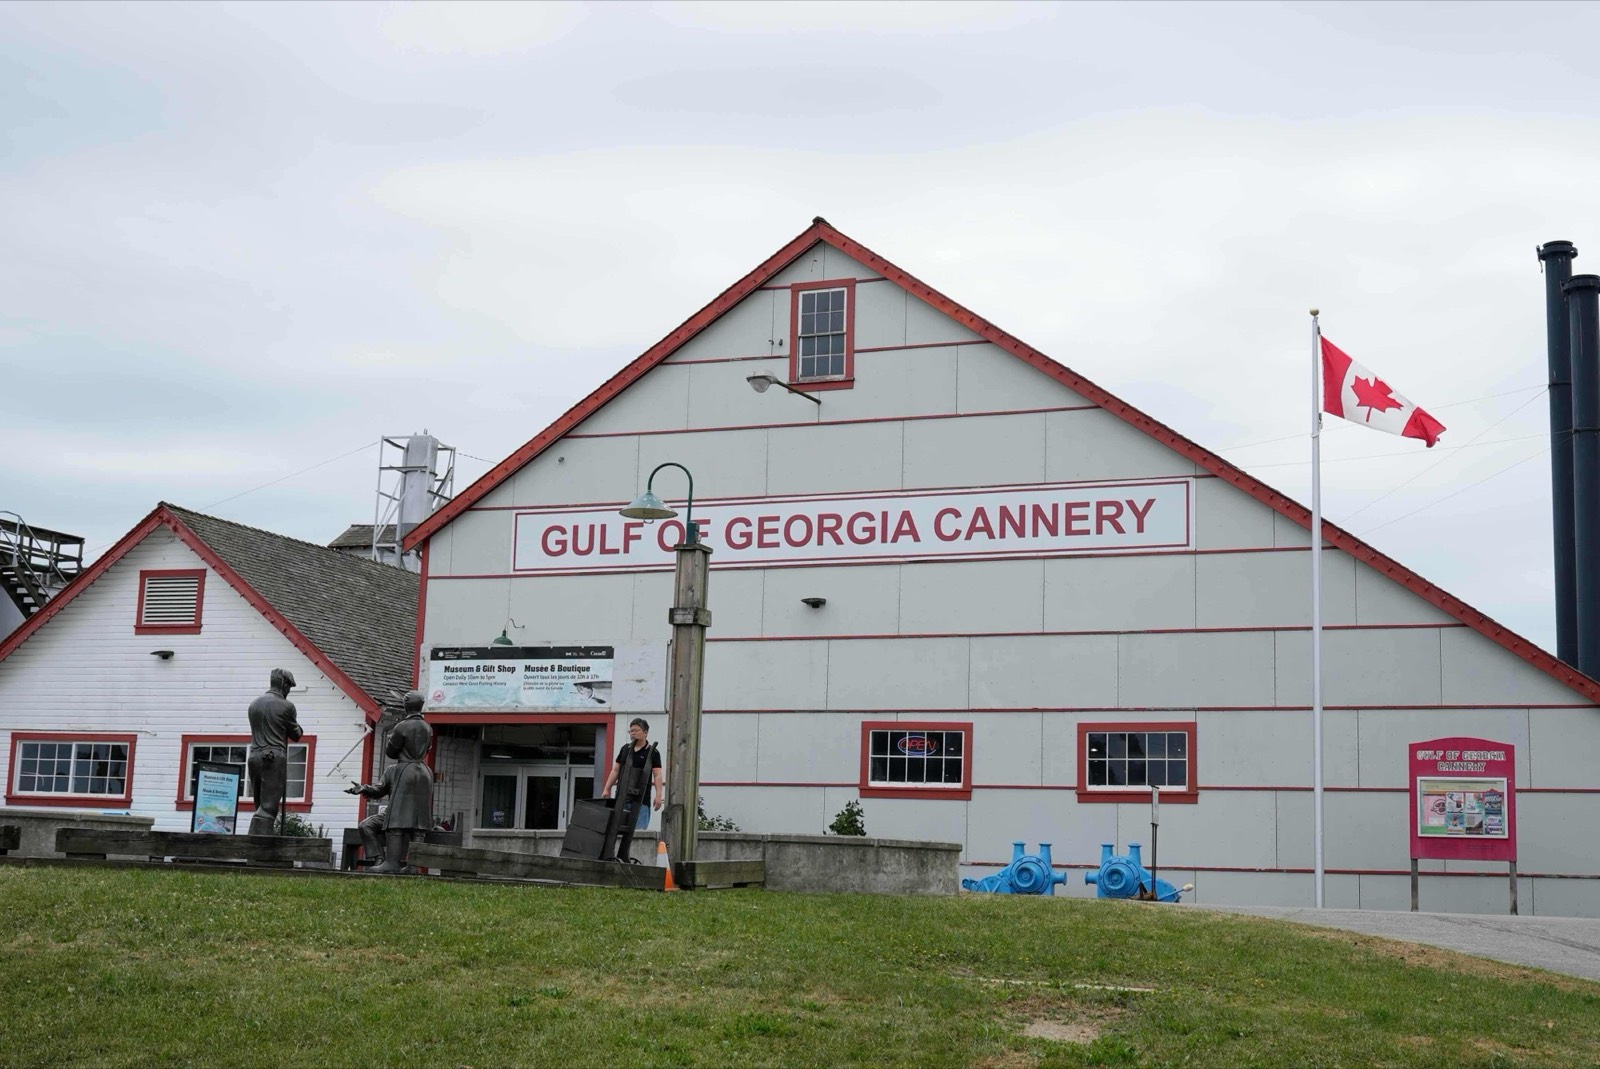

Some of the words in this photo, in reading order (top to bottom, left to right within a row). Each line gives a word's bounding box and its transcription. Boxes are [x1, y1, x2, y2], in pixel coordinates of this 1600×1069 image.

[541, 521, 645, 557] GULF
[724, 511, 920, 550] GEORGIA
[933, 498, 1157, 542] CANNERY
[443, 665, 475, 673] Museum
[475, 664, 481, 673] &
[482, 664, 496, 673] Gift
[497, 664, 516, 674] Shop
[524, 664, 549, 673] Musée
[550, 664, 556, 672] &
[557, 664, 591, 674] Boutique
[900, 739, 937, 751] OPEN
[1416, 750, 1443, 761] GULF
[1446, 750, 1460, 761] OF
[1462, 750, 1506, 761] GEORGIA
[1437, 761, 1487, 773] CANNERY
